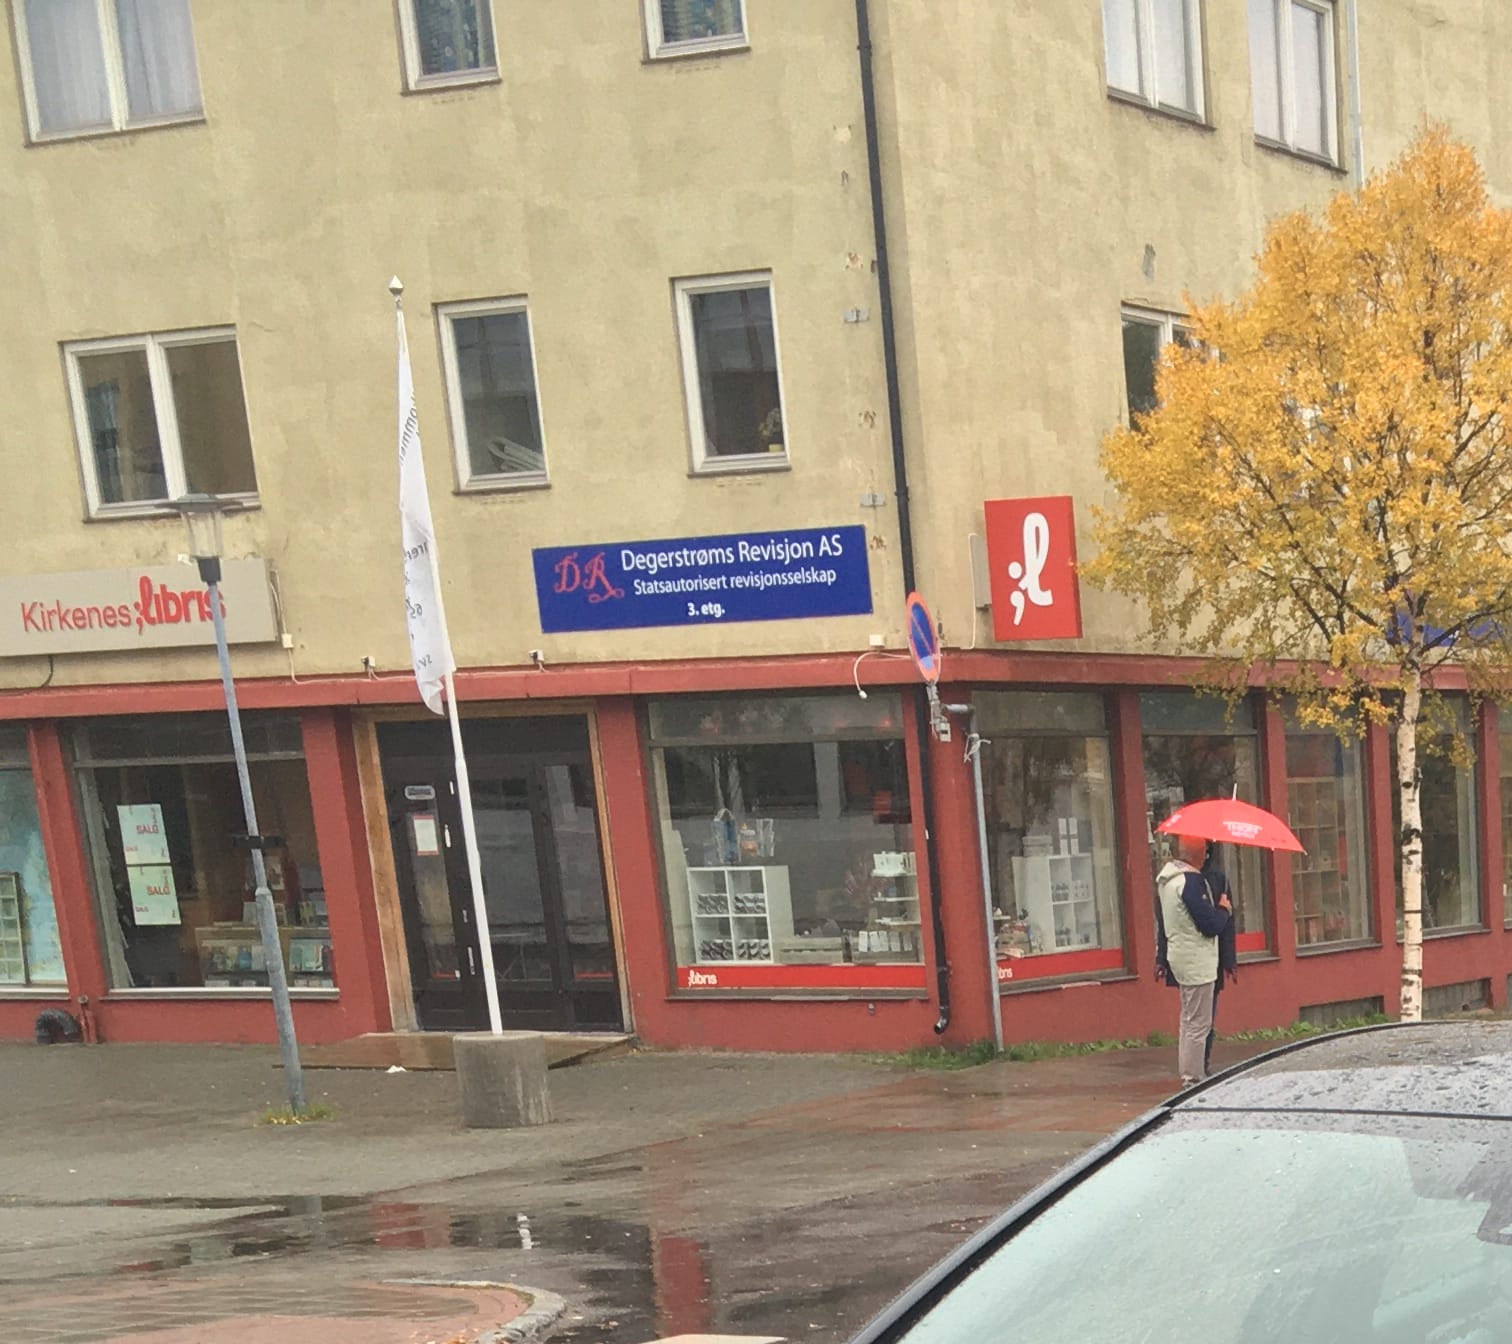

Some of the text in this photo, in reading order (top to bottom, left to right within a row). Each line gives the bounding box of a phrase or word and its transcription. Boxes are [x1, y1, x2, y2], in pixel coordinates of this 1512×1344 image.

[621, 534, 843, 575] Degerstrøms Revisjon AS
[634, 566, 837, 595] Statsautorisert revisjonsselskap
[21, 599, 132, 632] Kirkenes
[687, 602, 726, 618] 3. etg.
